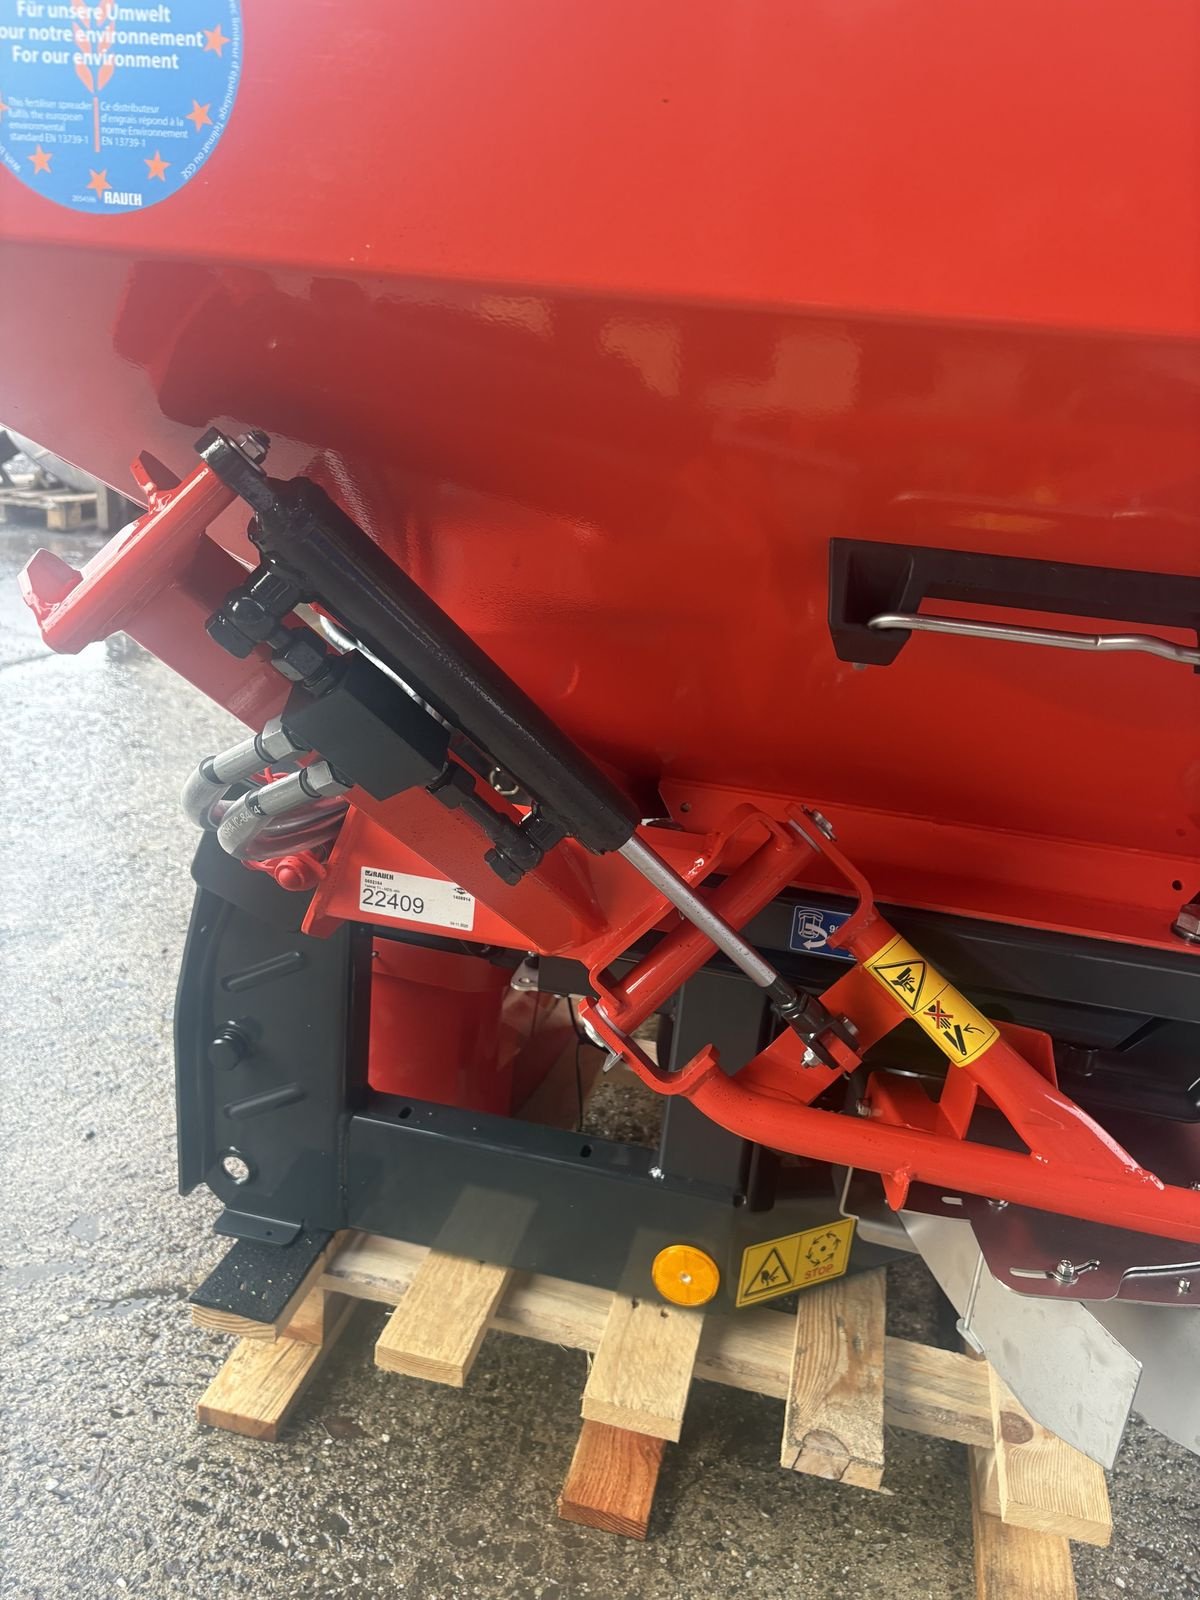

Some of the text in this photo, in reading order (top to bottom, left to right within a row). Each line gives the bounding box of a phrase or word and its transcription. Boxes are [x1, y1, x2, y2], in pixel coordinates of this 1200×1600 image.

[16, 0, 171, 22] Für unsere Umwelt
[0, 25, 204, 47] our notre environnement
[12, 45, 179, 69] For our environment
[58, 101, 93, 110] spreader
[100, 101, 160, 114] Ce distributeur
[101, 113, 138, 126] d'engrais
[176, 116, 184, 127] la
[9, 132, 44, 143] standard
[101, 126, 189, 139] norme Environnement
[101, 135, 146, 148] EN 13739-1
[103, 190, 143, 207] RAUCH
[372, 871, 394, 881] RAUCH
[362, 888, 424, 914] 22409
[804, 1263, 834, 1280] STOP
